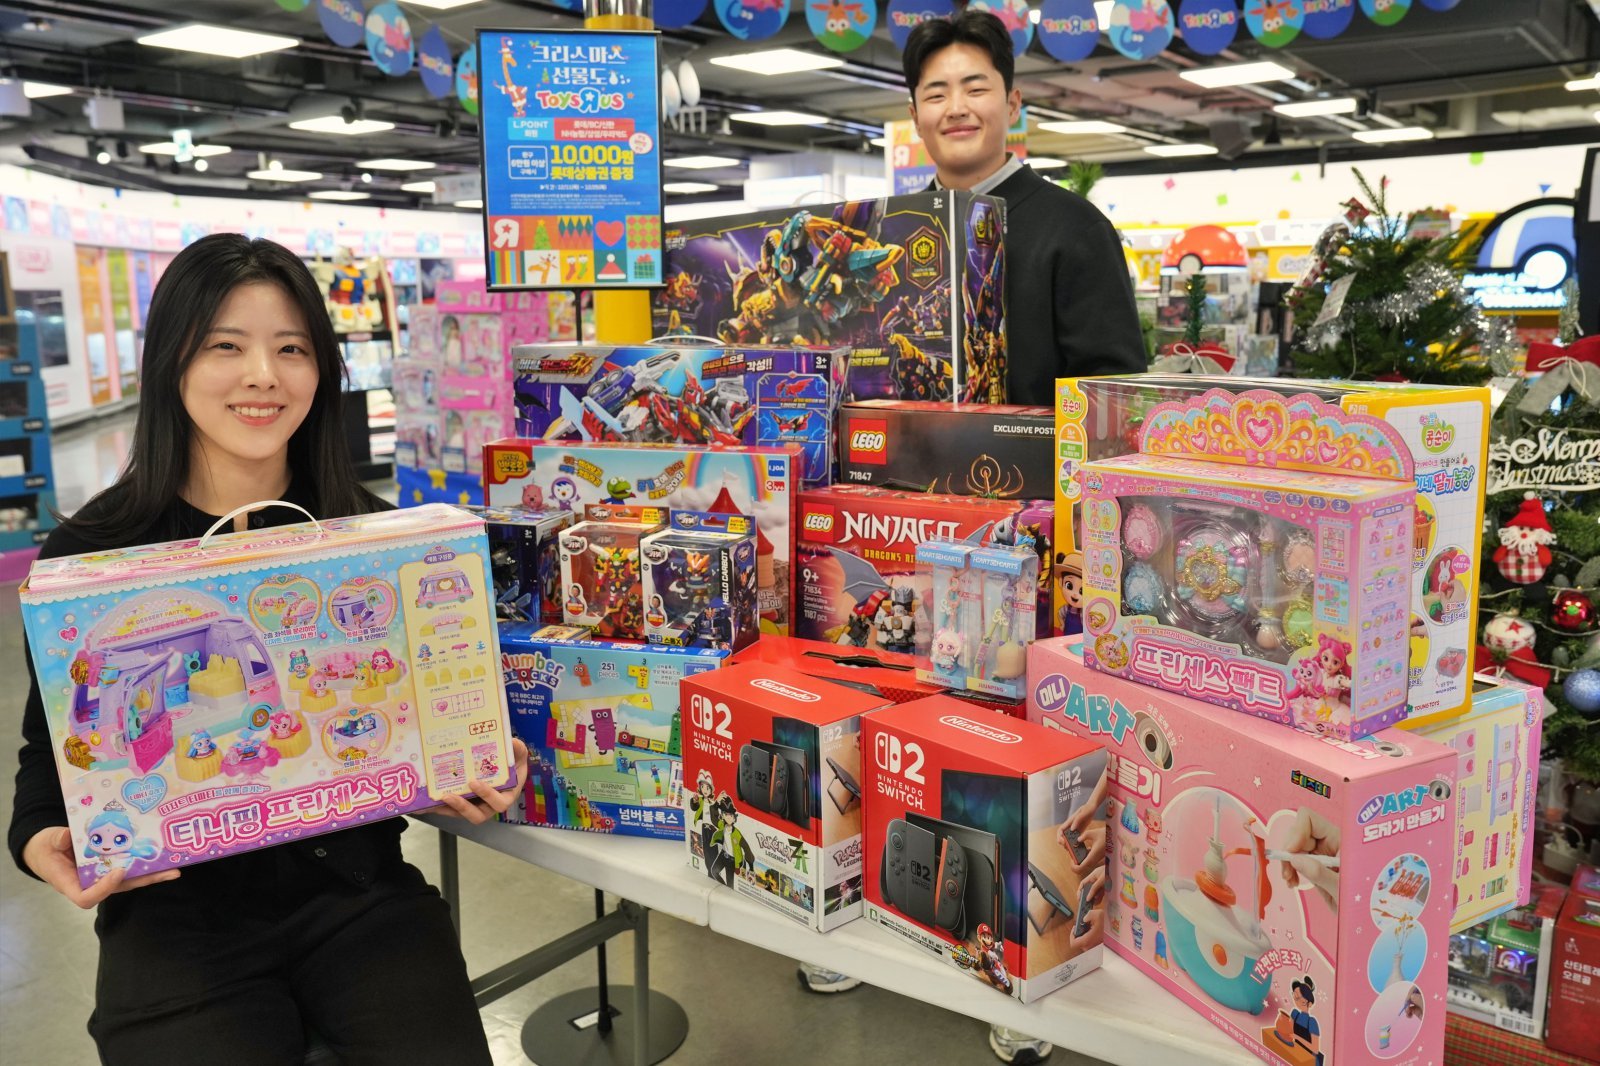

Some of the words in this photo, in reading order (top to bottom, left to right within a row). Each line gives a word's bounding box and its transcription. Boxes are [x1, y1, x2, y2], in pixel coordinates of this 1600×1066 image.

[532, 45, 627, 65] 크리스마스
[513, 121, 549, 129] L.POINT
[551, 145, 634, 165] 10,000원
[816, 356, 827, 365] 3+
[994, 425, 1033, 434] EXCLUSIVE
[1035, 426, 1055, 435] POST
[1426, 430, 1451, 447] 콩순이
[851, 432, 885, 451] LEGO
[849, 471, 871, 481] 71847
[804, 514, 834, 532] LEGO
[838, 511, 961, 548] NINJAGO
[864, 549, 901, 561] DRAGONS
[803, 569, 819, 582] 9+
[804, 585, 822, 595] 71834
[135, 612, 163, 624] DESSERT
[164, 609, 184, 618] PARTY
[804, 610, 816, 619] 1187
[817, 614, 827, 622] pcs
[501, 651, 565, 677] Number
[602, 663, 615, 671] 251
[599, 671, 619, 679] pieces
[1137, 647, 1228, 690] 프린세스
[1231, 670, 1280, 704] 팩트
[520, 692, 531, 700] BBC
[759, 679, 816, 701] Nintendo
[715, 701, 733, 740] 2
[1039, 679, 1066, 706] 미니
[1064, 682, 1136, 746] ART
[947, 716, 1016, 742] Nintendo
[693, 731, 732, 750] NINTENDO
[693, 738, 732, 762] SWITCH
[904, 744, 926, 785] 2
[877, 773, 923, 797] NINTENDO
[1072, 766, 1082, 785] 2
[160, 798, 187, 815] 디저트
[188, 787, 223, 804] 티파티를
[877, 782, 924, 810] SWITCH
[1059, 791, 1081, 803] SWITCH
[1360, 797, 1382, 822] 미니
[1382, 785, 1430, 816] ART
[619, 808, 679, 824] 넘버블록스
[1363, 818, 1404, 842] 도자기
[1406, 805, 1445, 830] 만들기
[172, 805, 260, 847] 티니핑
[765, 851, 787, 864] LEGENDS
[1254, 950, 1281, 979] 간편한
[1281, 949, 1302, 971] 조작
